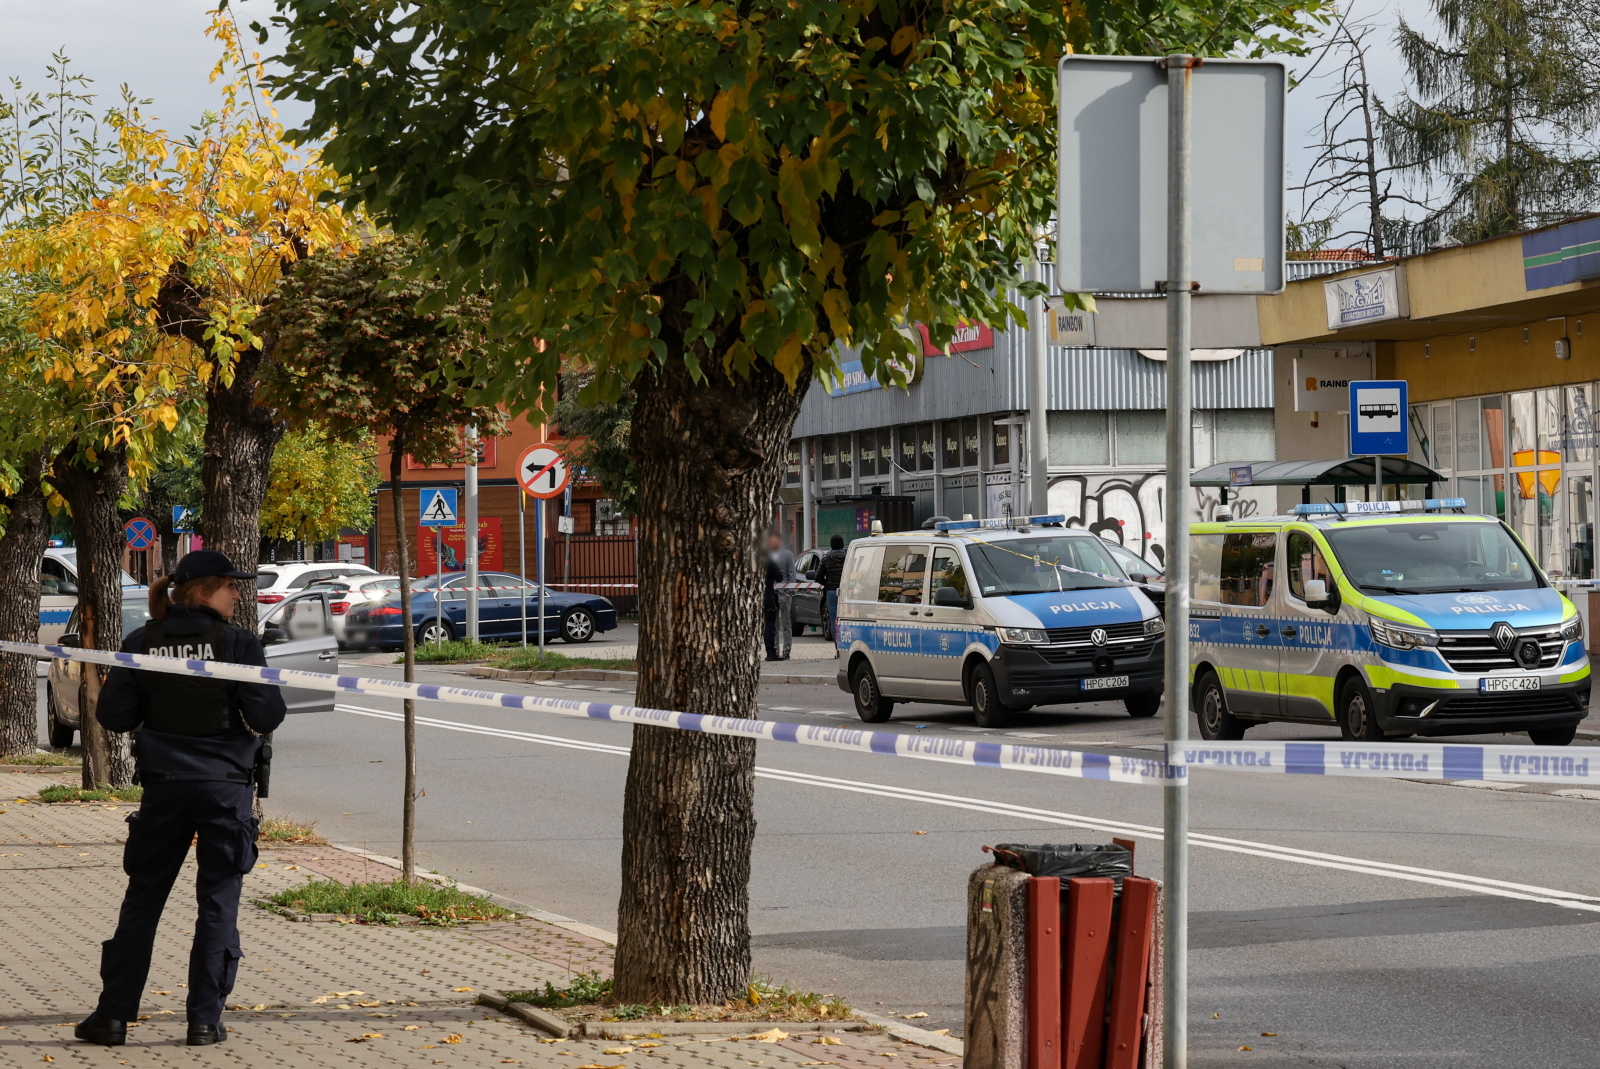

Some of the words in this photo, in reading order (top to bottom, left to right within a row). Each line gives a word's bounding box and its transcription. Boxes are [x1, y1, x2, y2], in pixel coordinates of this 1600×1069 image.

[1337, 276, 1385, 311] DIAGMED
[1058, 315, 1083, 332] RAINBOW
[952, 325, 981, 343] aszamy
[1320, 380, 1349, 388] RAINB
[1357, 502, 1390, 511] POLICJA
[1049, 601, 1122, 614] POLICJA
[1450, 603, 1531, 615] POLICJA
[883, 631, 912, 648] POLICJA
[1299, 625, 1332, 646] POLICJA
[149, 643, 215, 660] POLICJA
[1086, 678, 1104, 690] HPG
[1105, 676, 1127, 688] C206
[1487, 679, 1508, 691] HPG
[1512, 678, 1538, 690] C426
[806, 725, 862, 746] POLICJA
[906, 734, 967, 758] POLICJA
[1011, 745, 1073, 769] POLICJA
[1183, 750, 1271, 767] POLICJA
[1340, 751, 1429, 772] POLICJA
[1499, 754, 1589, 777] POLICJA
